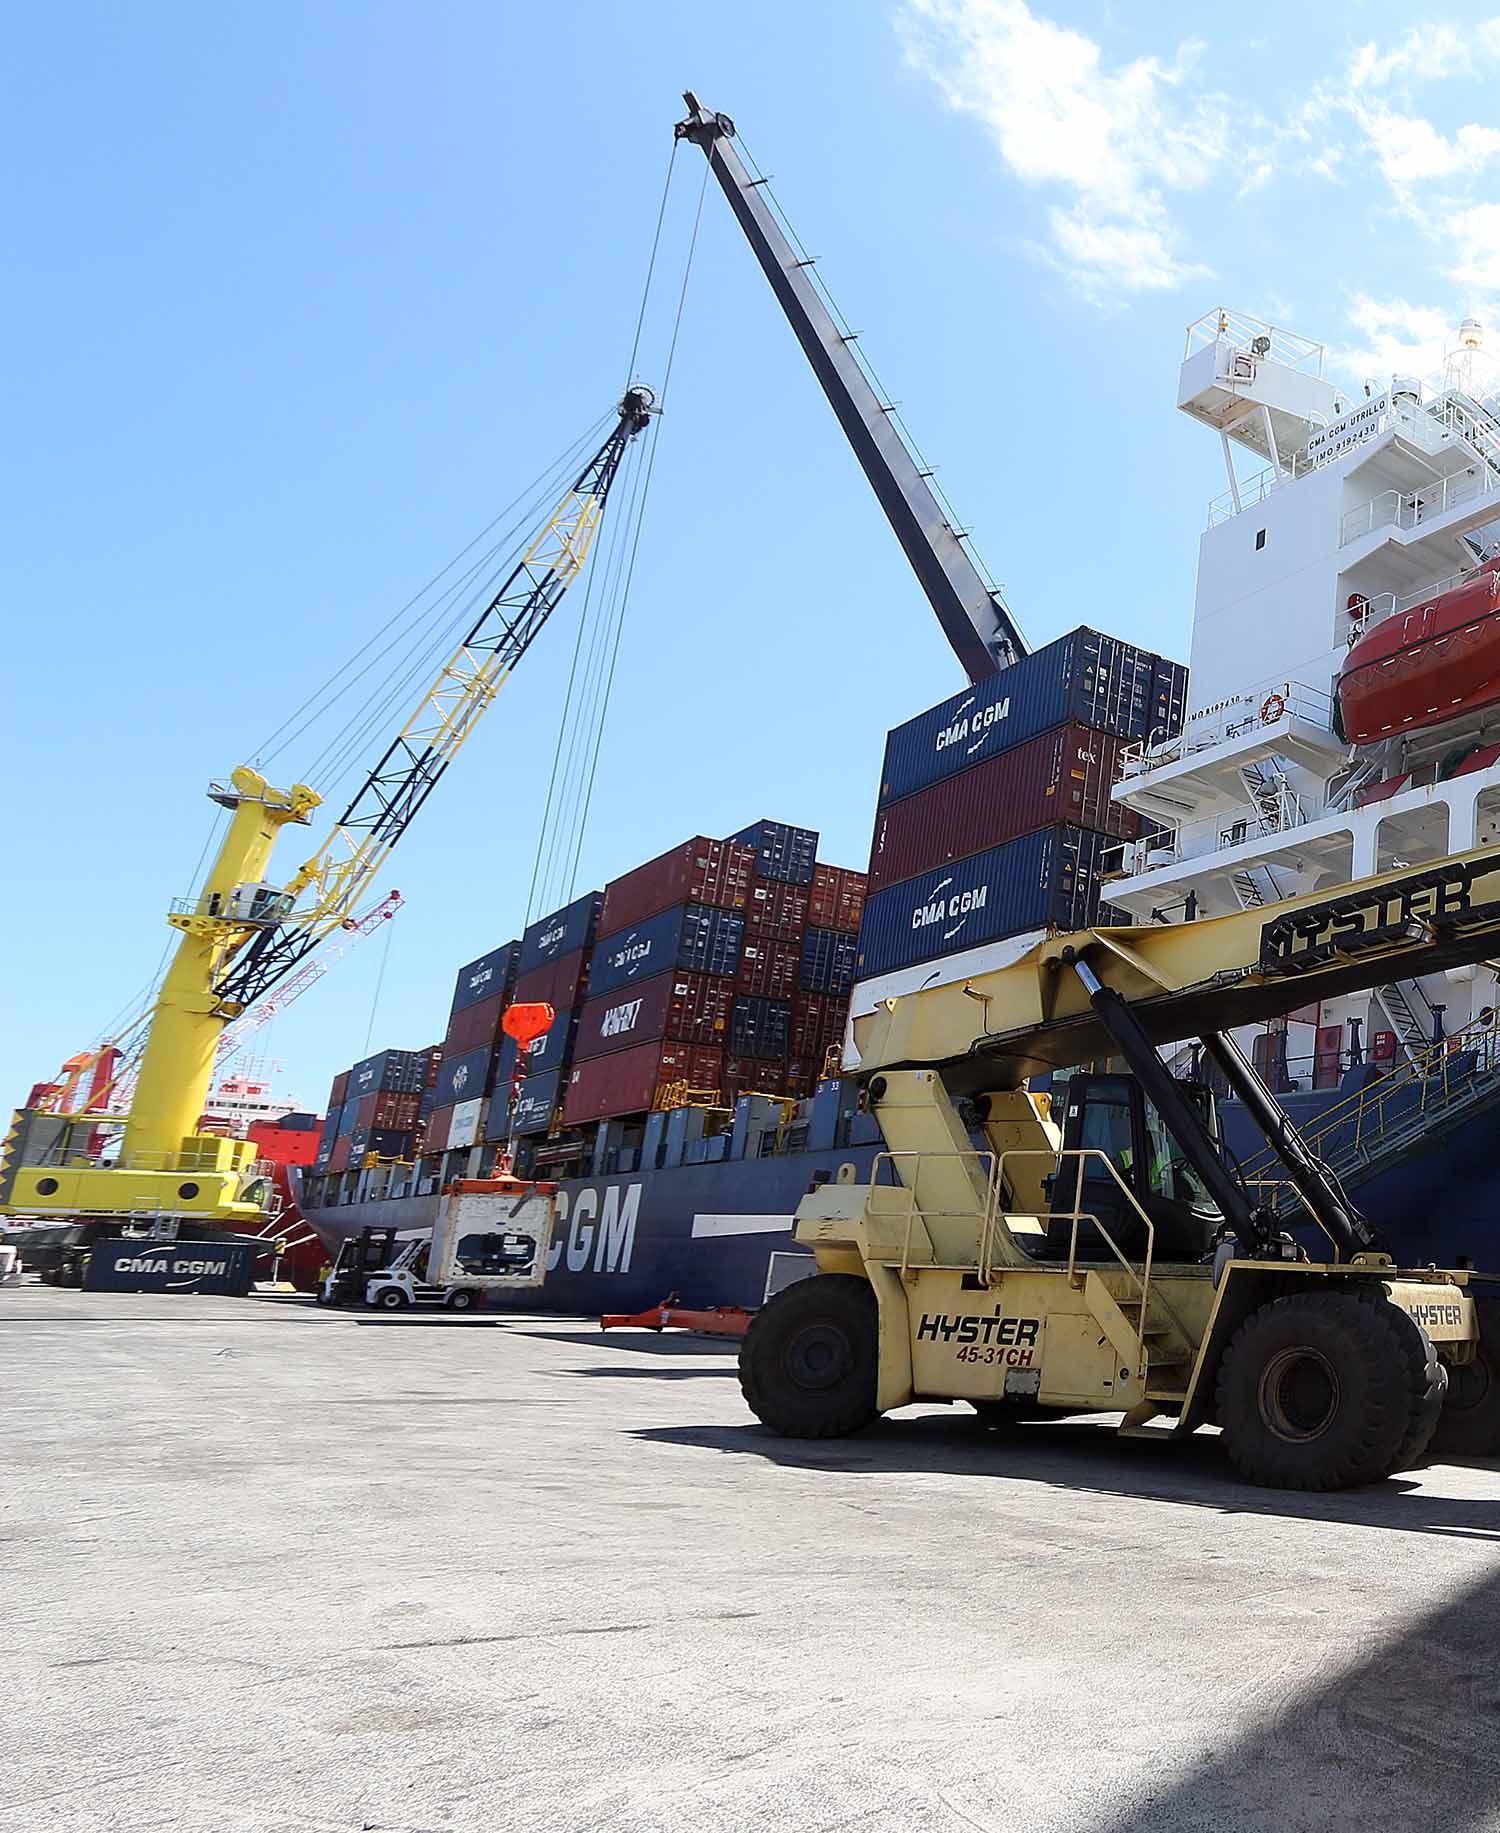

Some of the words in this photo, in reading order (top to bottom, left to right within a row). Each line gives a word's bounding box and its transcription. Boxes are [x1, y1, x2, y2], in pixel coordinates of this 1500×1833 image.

[1309, 435, 1325, 450] CMA
[1329, 423, 1346, 438] CGM
[1350, 400, 1385, 426] UTRILLO
[1316, 447, 1333, 462] IMO
[1336, 423, 1375, 451] 9192430
[936, 719, 968, 751] CMA
[972, 697, 1010, 732] CGM
[1077, 747, 1097, 764] tex
[912, 900, 945, 929] CMA
[949, 885, 987, 916] CGM
[114, 1259, 168, 1273] CMA
[173, 1260, 226, 1275] CGM
[917, 1314, 1040, 1346] HYSTER
[1409, 1305, 1462, 1325] HYSTER
[956, 1346, 1034, 1366] 45-31CH
